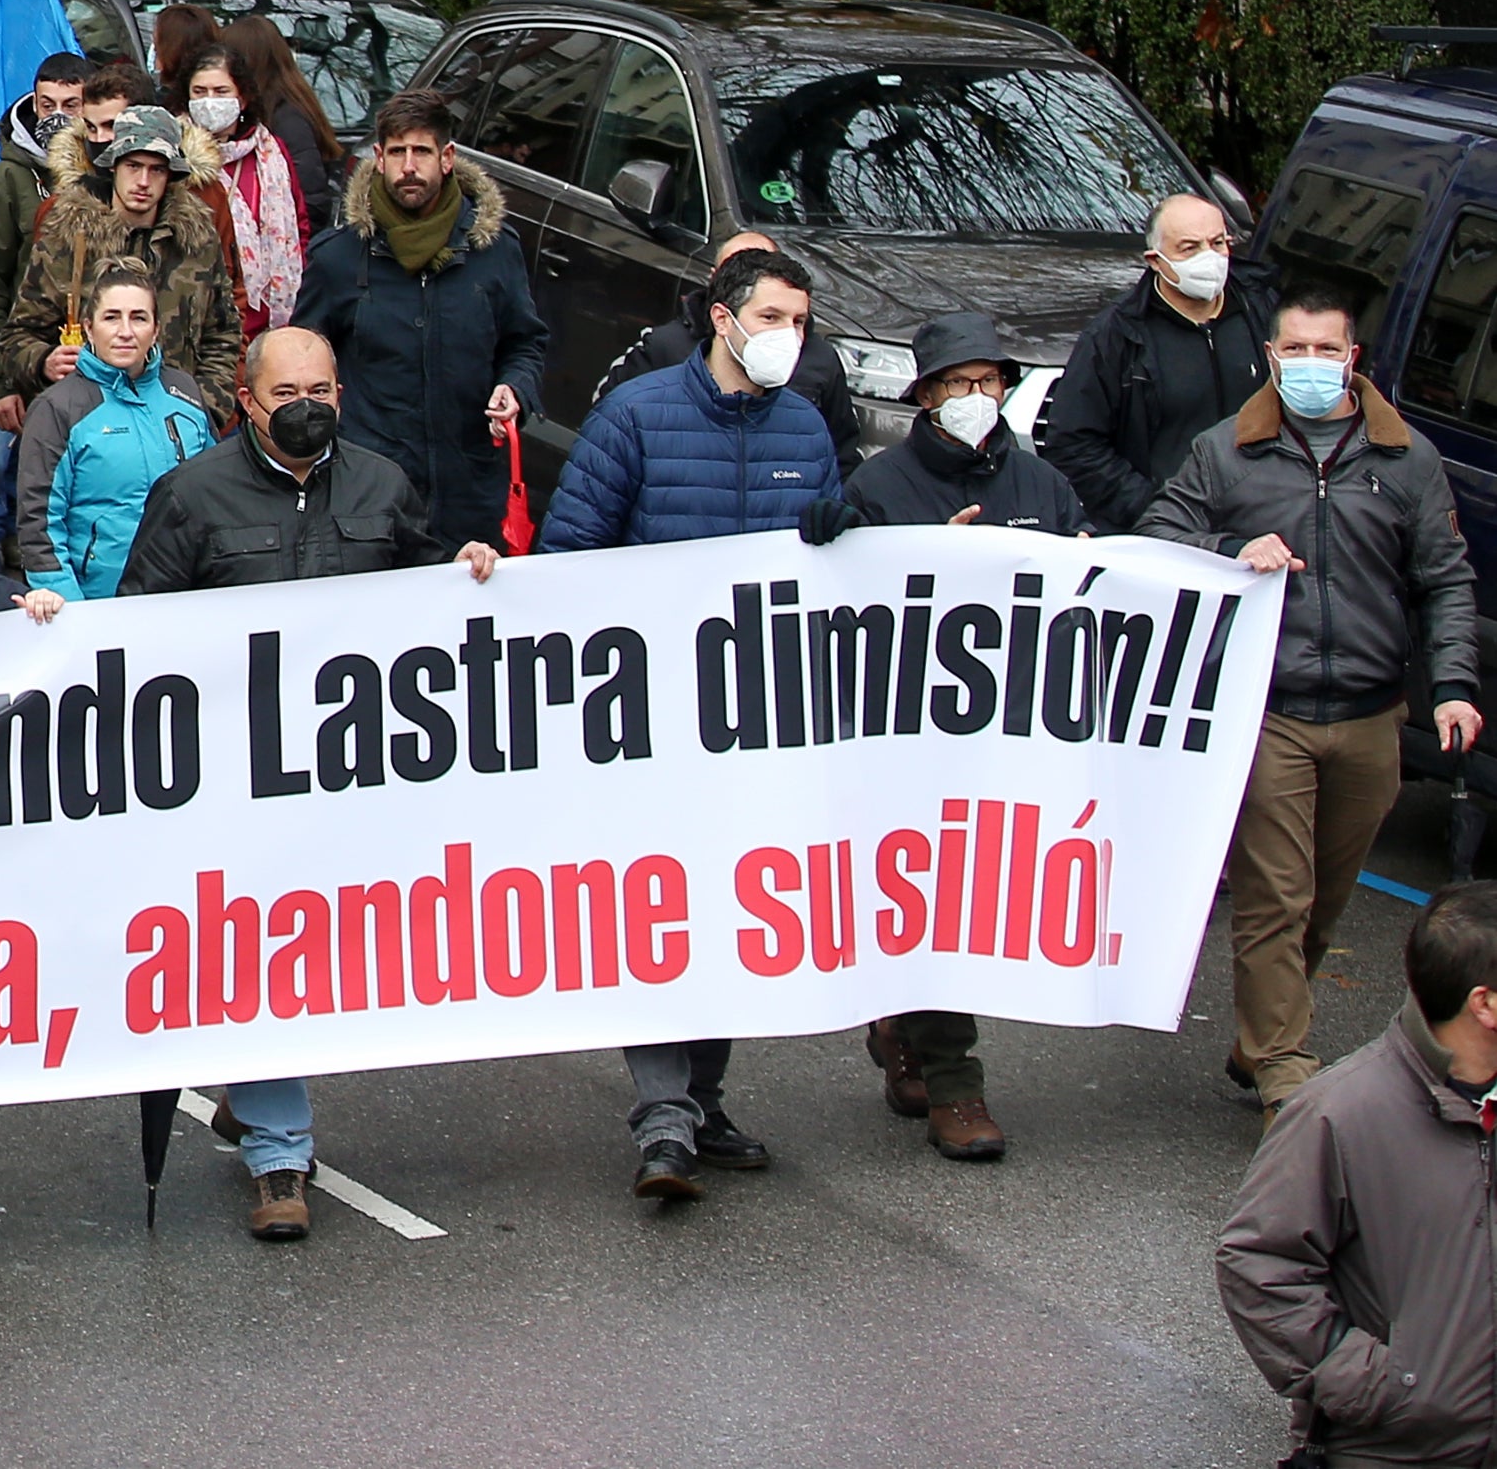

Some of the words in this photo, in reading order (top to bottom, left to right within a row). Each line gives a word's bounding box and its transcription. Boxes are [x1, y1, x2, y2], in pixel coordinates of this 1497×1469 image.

[248, 616, 652, 799] Lastra
[695, 565, 1242, 753] dimisión!!
[124, 842, 690, 1035] abandone
[735, 838, 857, 977] su
